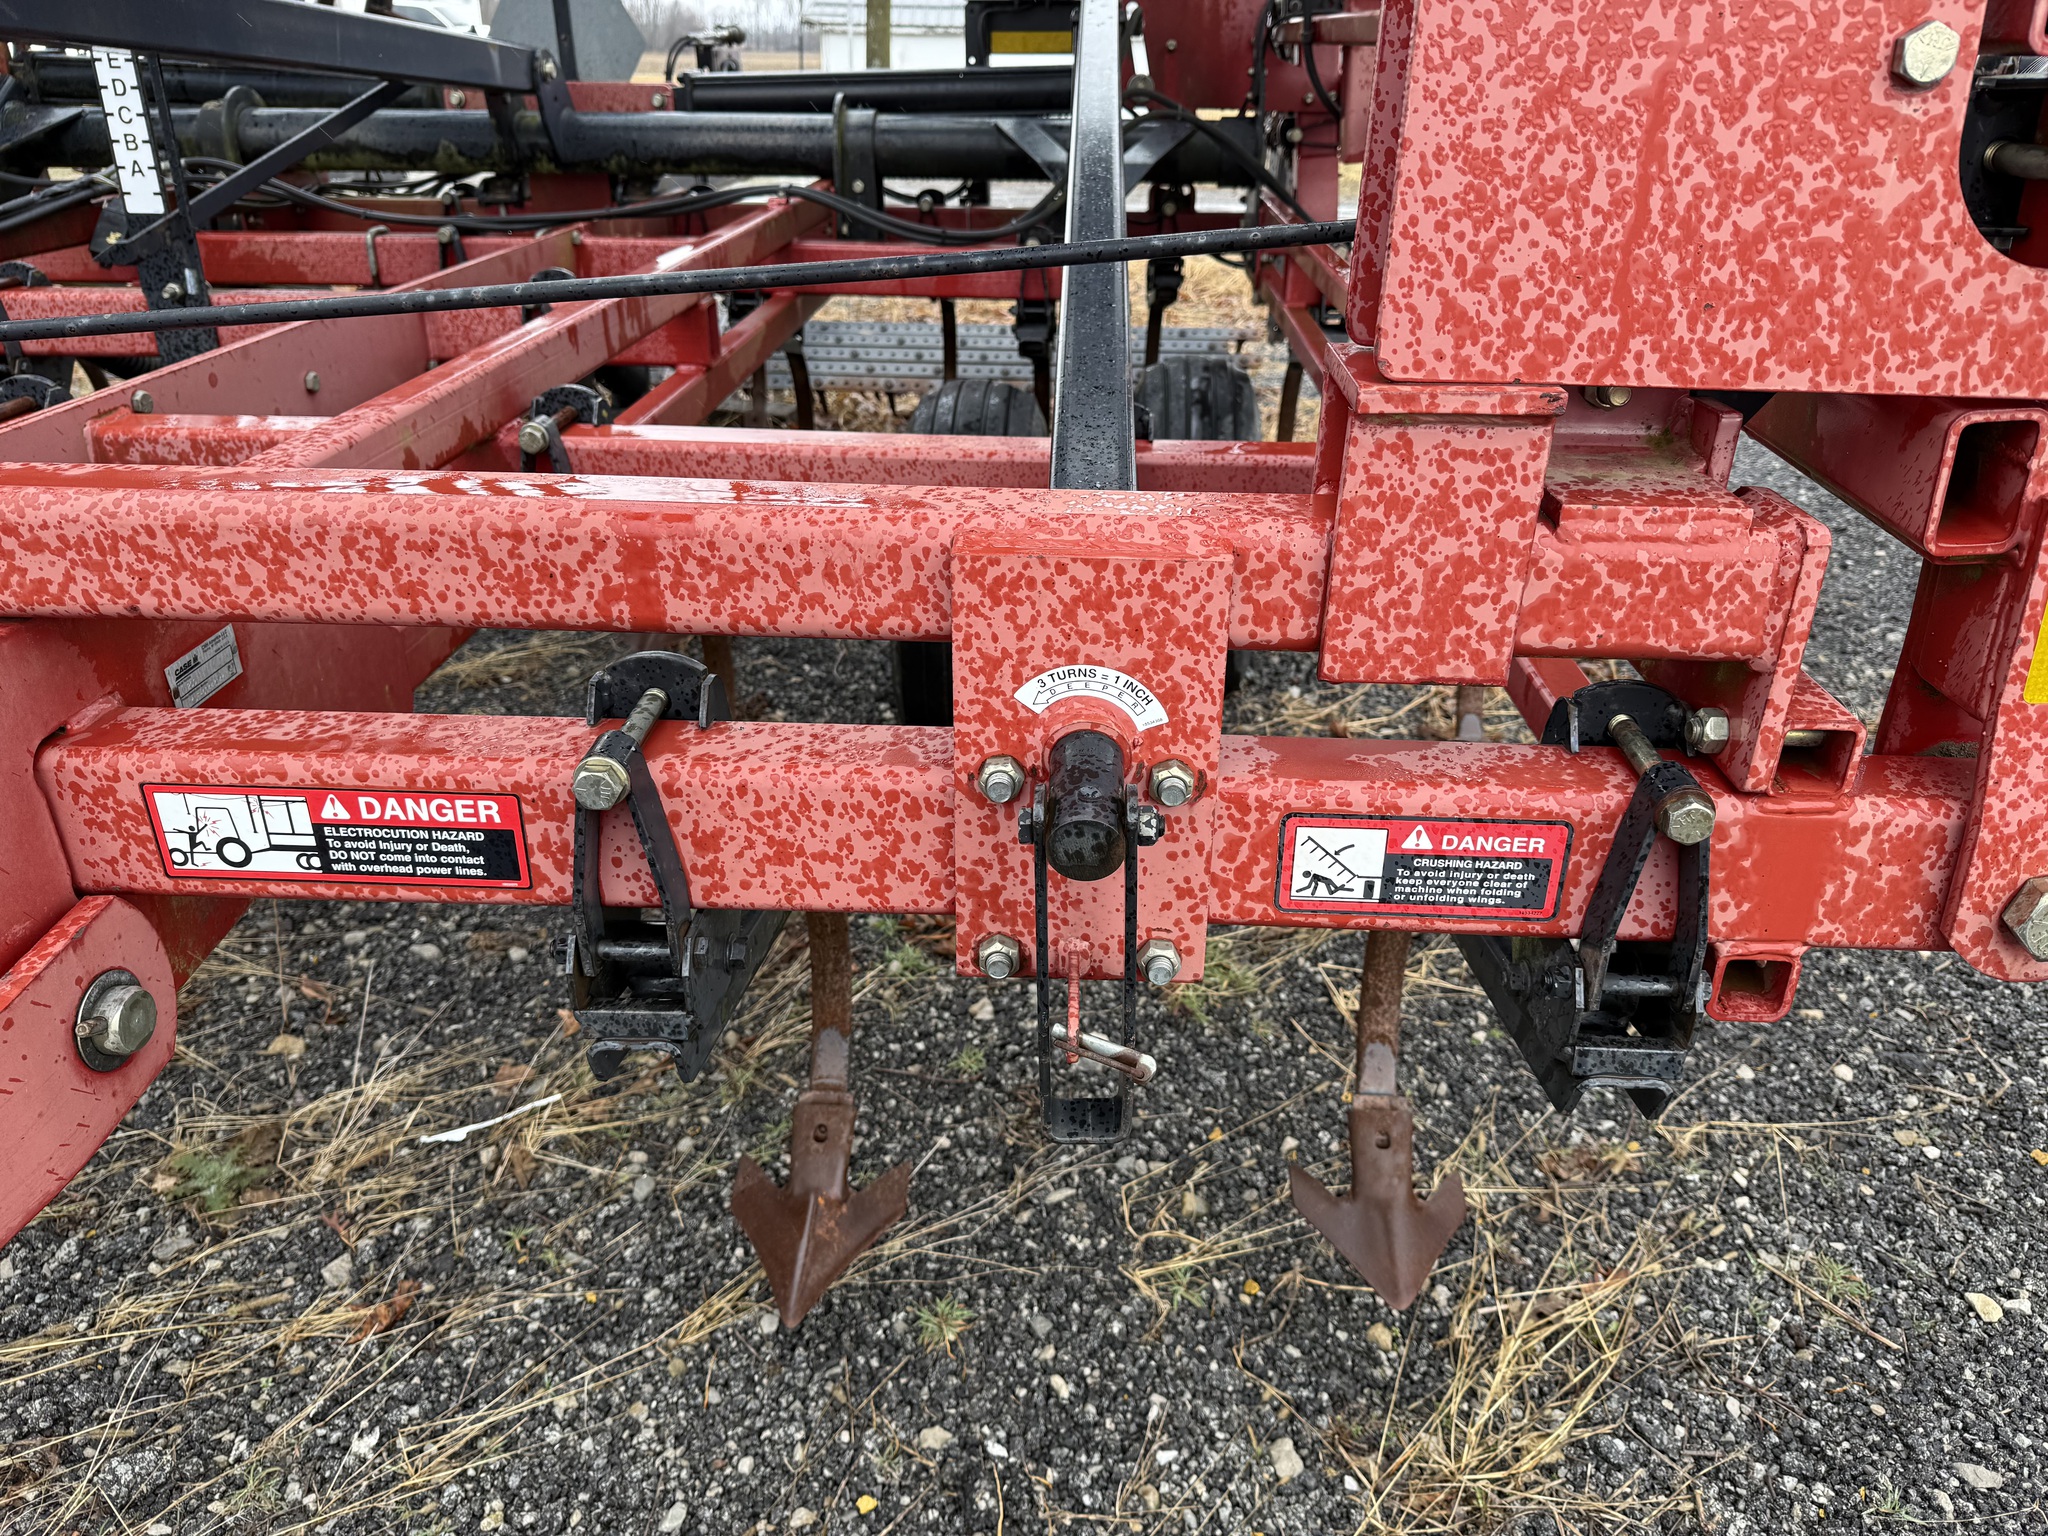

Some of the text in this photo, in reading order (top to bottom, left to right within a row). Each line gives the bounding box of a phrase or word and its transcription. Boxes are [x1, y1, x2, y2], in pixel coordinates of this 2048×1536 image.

[107, 53, 121, 69] E
[111, 78, 127, 96] D
[118, 106, 133, 124] C
[123, 133, 139, 151] B
[131, 160, 145, 178] A
[174, 659, 192, 676] CASE
[1037, 678, 1046, 688] 3
[1047, 668, 1097, 683] TURNS
[1114, 675, 1121, 684] 1
[1122, 679, 1153, 706] INCH
[358, 796, 501, 823] DANGER
[323, 826, 485, 841] ELECTROCUTION HAZARD
[325, 838, 470, 854] To avoid Injury or Death,
[1442, 835, 1546, 853] DANGER
[329, 850, 485, 864] DO NOT come into contact
[1413, 858, 1523, 870] CRUSHING HAZARD
[331, 862, 487, 876] with overhead power lines.
[1397, 868, 1410, 876] To
[1449, 870, 1483, 880] injury
[1503, 872, 1536, 881] death
[1395, 877, 1529, 889] keep everyone clear of
[1394, 886, 1522, 898] machine when folding
[1409, 894, 1464, 904] unfolding
[1468, 896, 1505, 905] wings.
